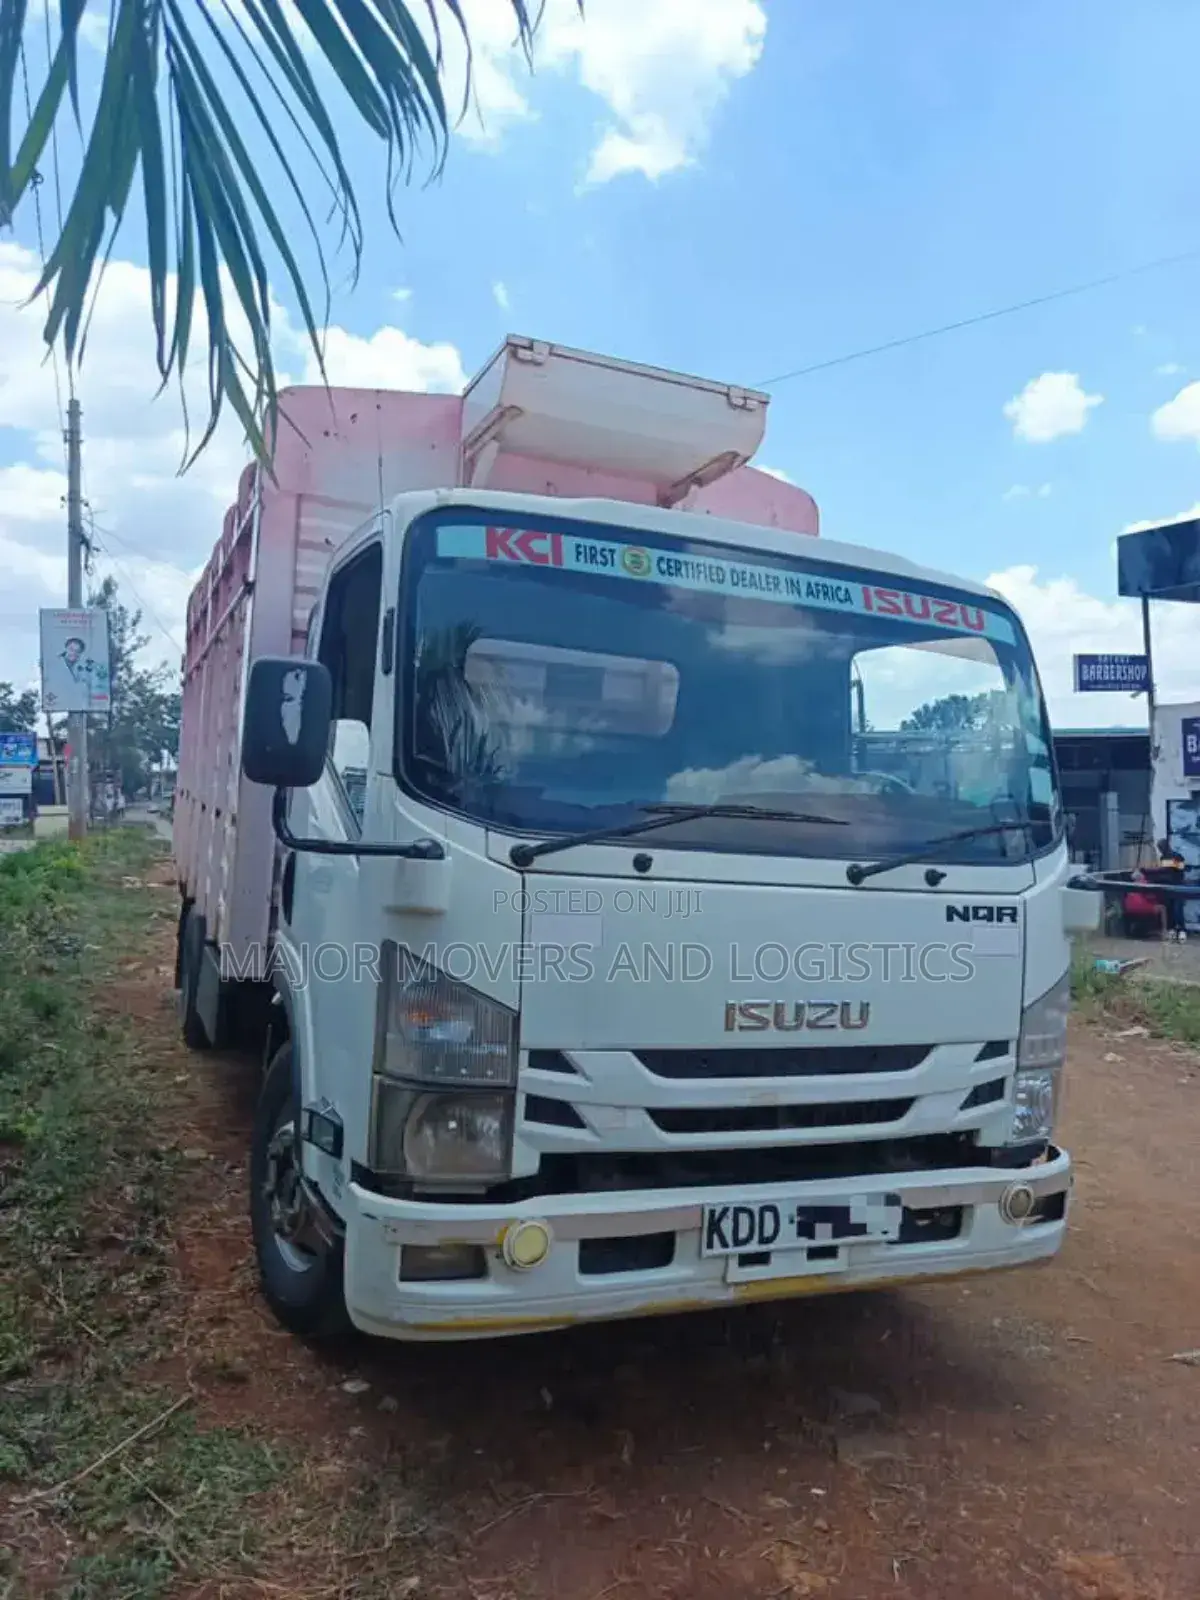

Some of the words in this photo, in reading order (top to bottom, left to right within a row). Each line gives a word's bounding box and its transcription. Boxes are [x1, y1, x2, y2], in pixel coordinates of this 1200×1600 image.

[485, 526, 564, 567] KCI
[575, 543, 616, 567] FIRST
[656, 556, 726, 585] CERTIFIED
[730, 567, 782, 596] DEALER
[784, 576, 801, 598] IN
[805, 579, 853, 606] AFRICA
[861, 586, 985, 631] ISUZU
[1081, 664, 1148, 681] BARBERSHOP
[946, 905, 1018, 923] NQR
[723, 1001, 871, 1033] ISUZU
[706, 1205, 780, 1249] KDD
